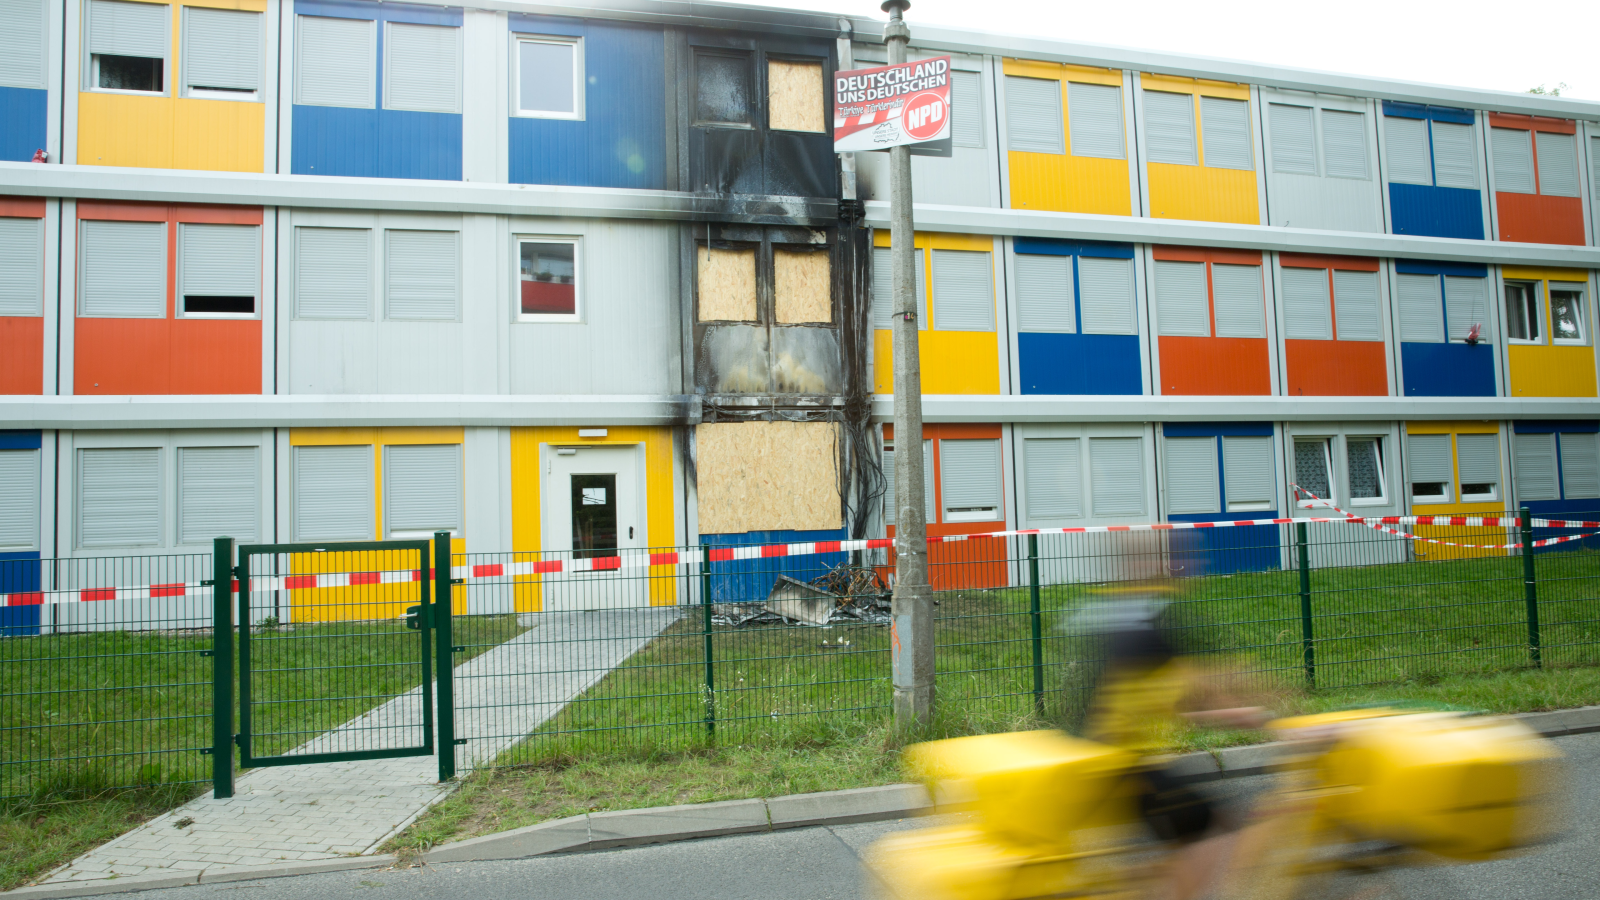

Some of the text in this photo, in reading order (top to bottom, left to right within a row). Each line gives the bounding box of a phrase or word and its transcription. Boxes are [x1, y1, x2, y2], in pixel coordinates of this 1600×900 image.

[837, 59, 947, 92] DEUTSCHLAND
[837, 74, 947, 104] UNS DEUTSCHEN
[838, 106, 864, 117] Türkiye
[908, 100, 943, 131] NPD
